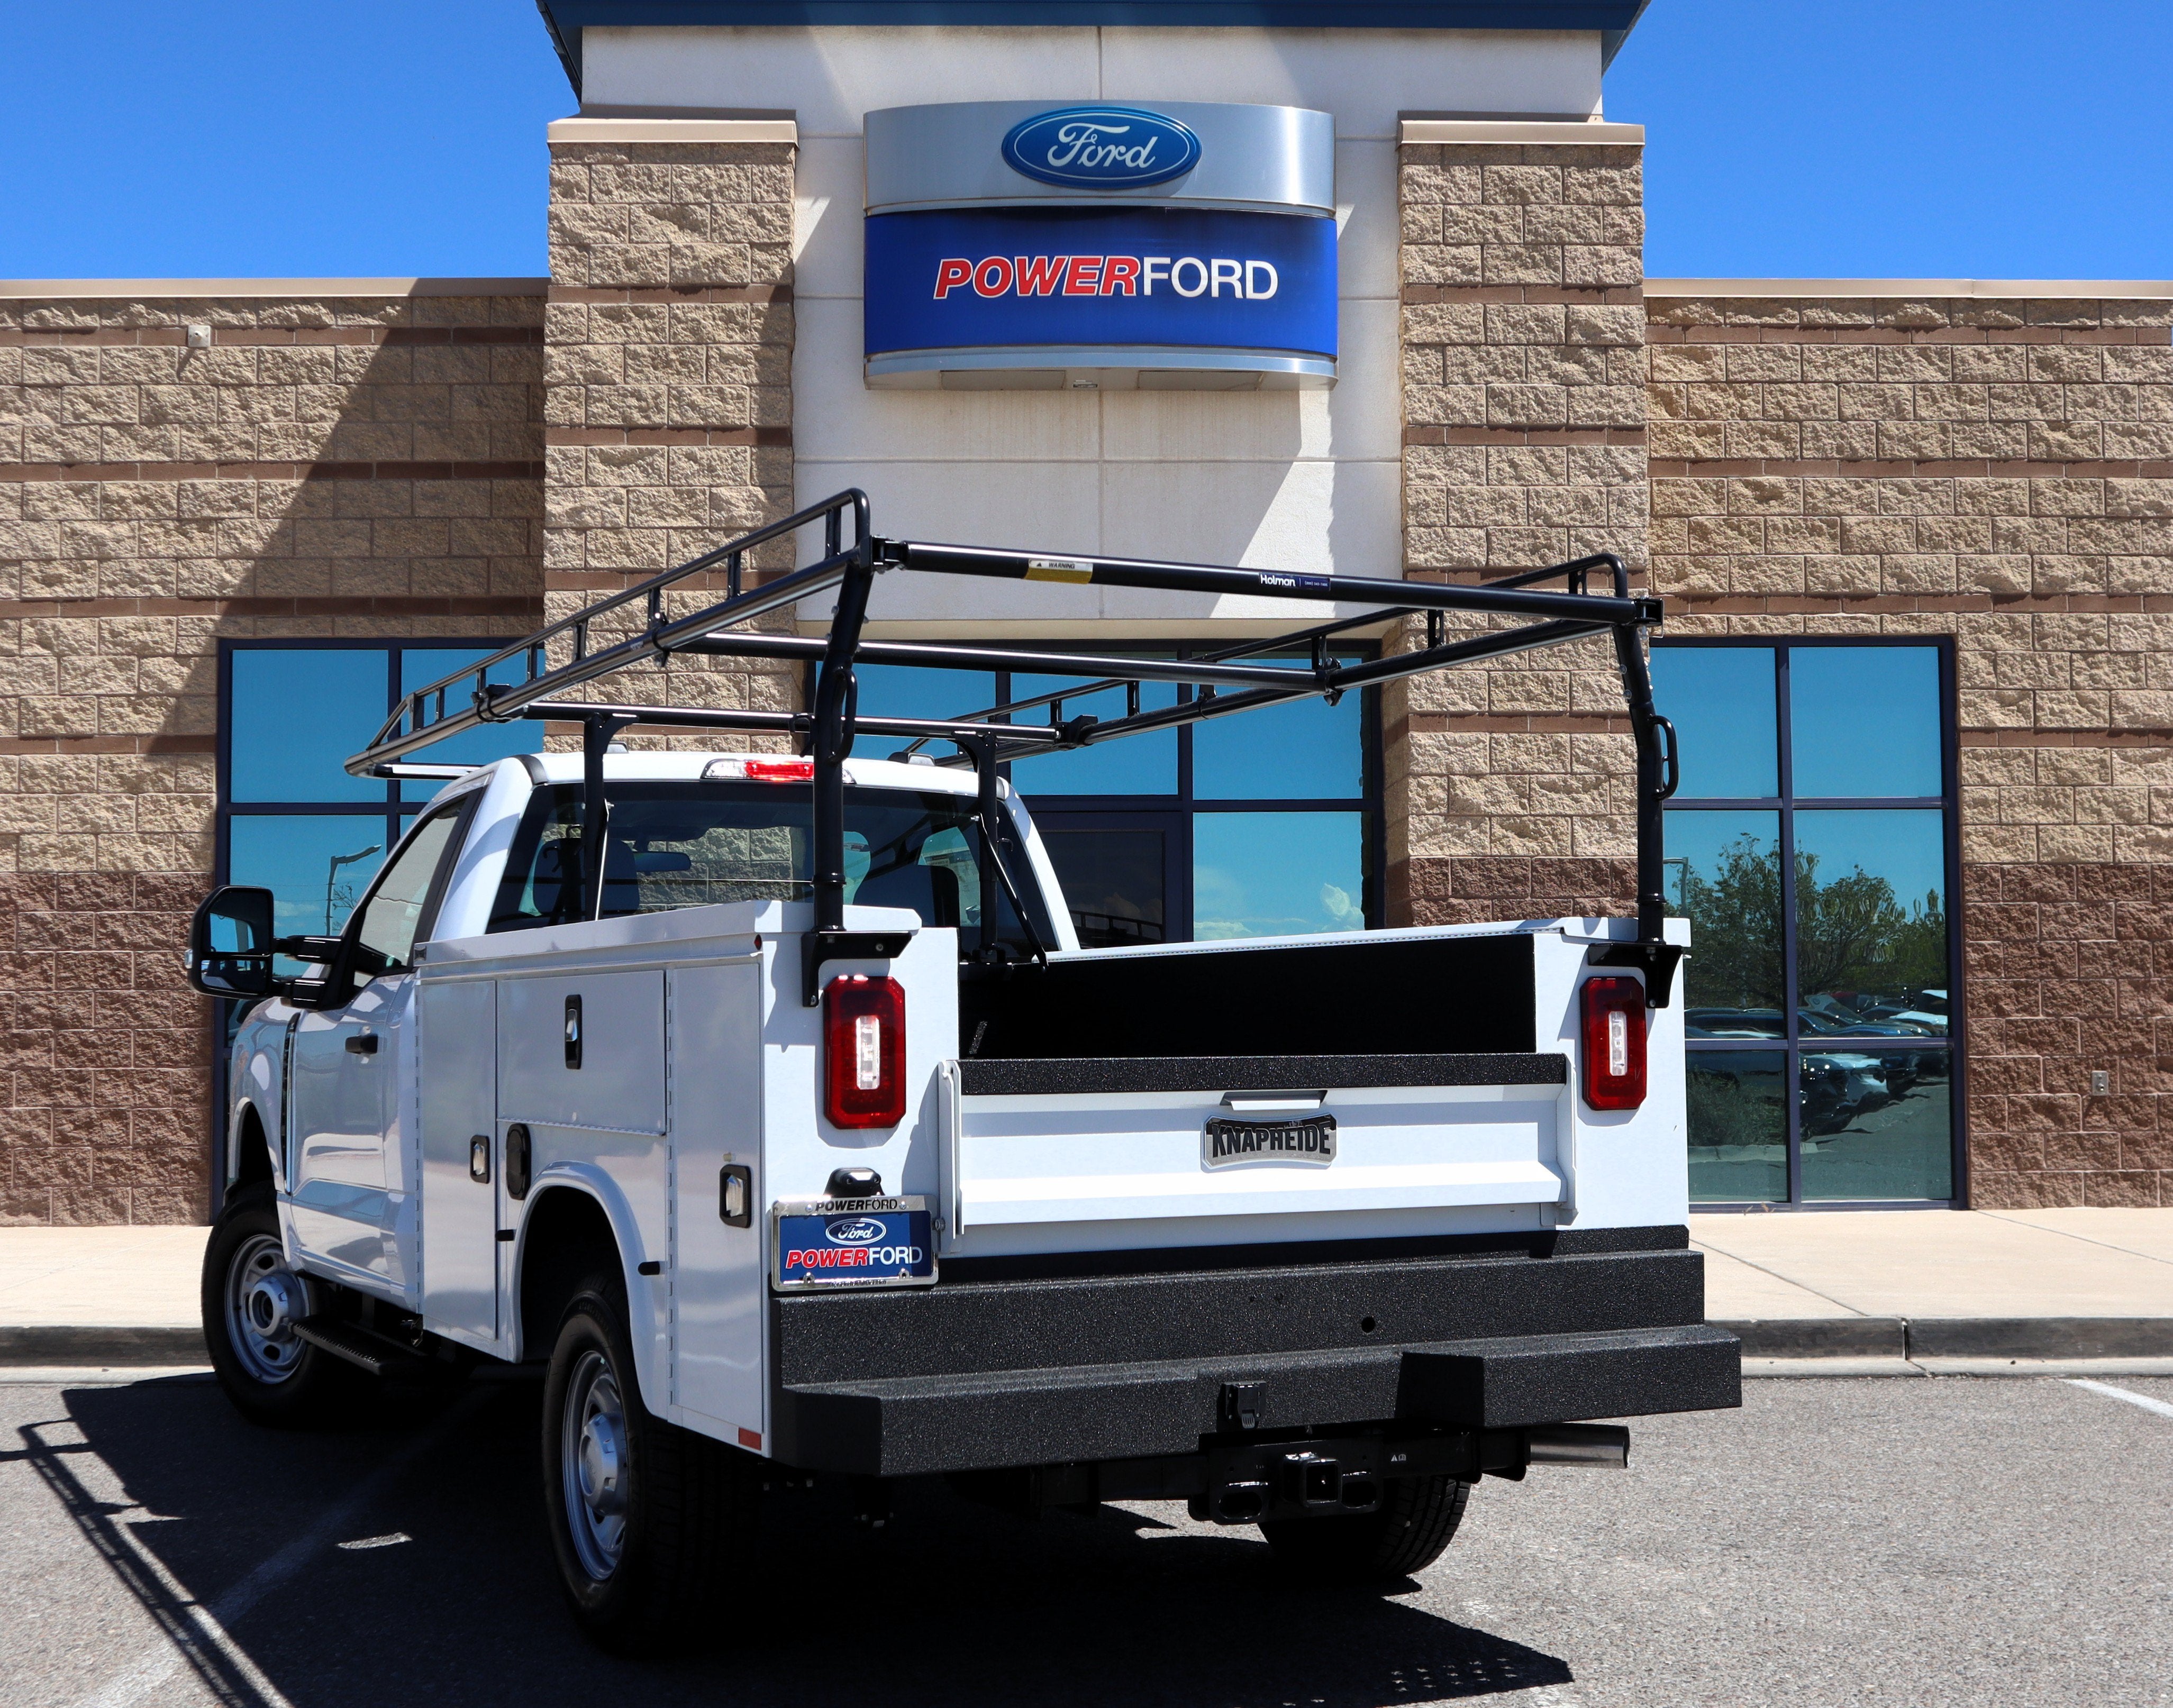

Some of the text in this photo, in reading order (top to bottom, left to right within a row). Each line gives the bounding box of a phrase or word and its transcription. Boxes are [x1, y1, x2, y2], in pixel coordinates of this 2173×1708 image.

[1047, 122, 1158, 169] Ford
[933, 255, 1279, 300] POWERFORD
[1260, 574, 1296, 587] Holman
[1212, 1120, 1331, 1158] KNAPHEIDE
[815, 1199, 897, 1212] POWERFORD
[838, 1222, 874, 1239] Ford
[786, 1246, 923, 1269] POWERFORD
